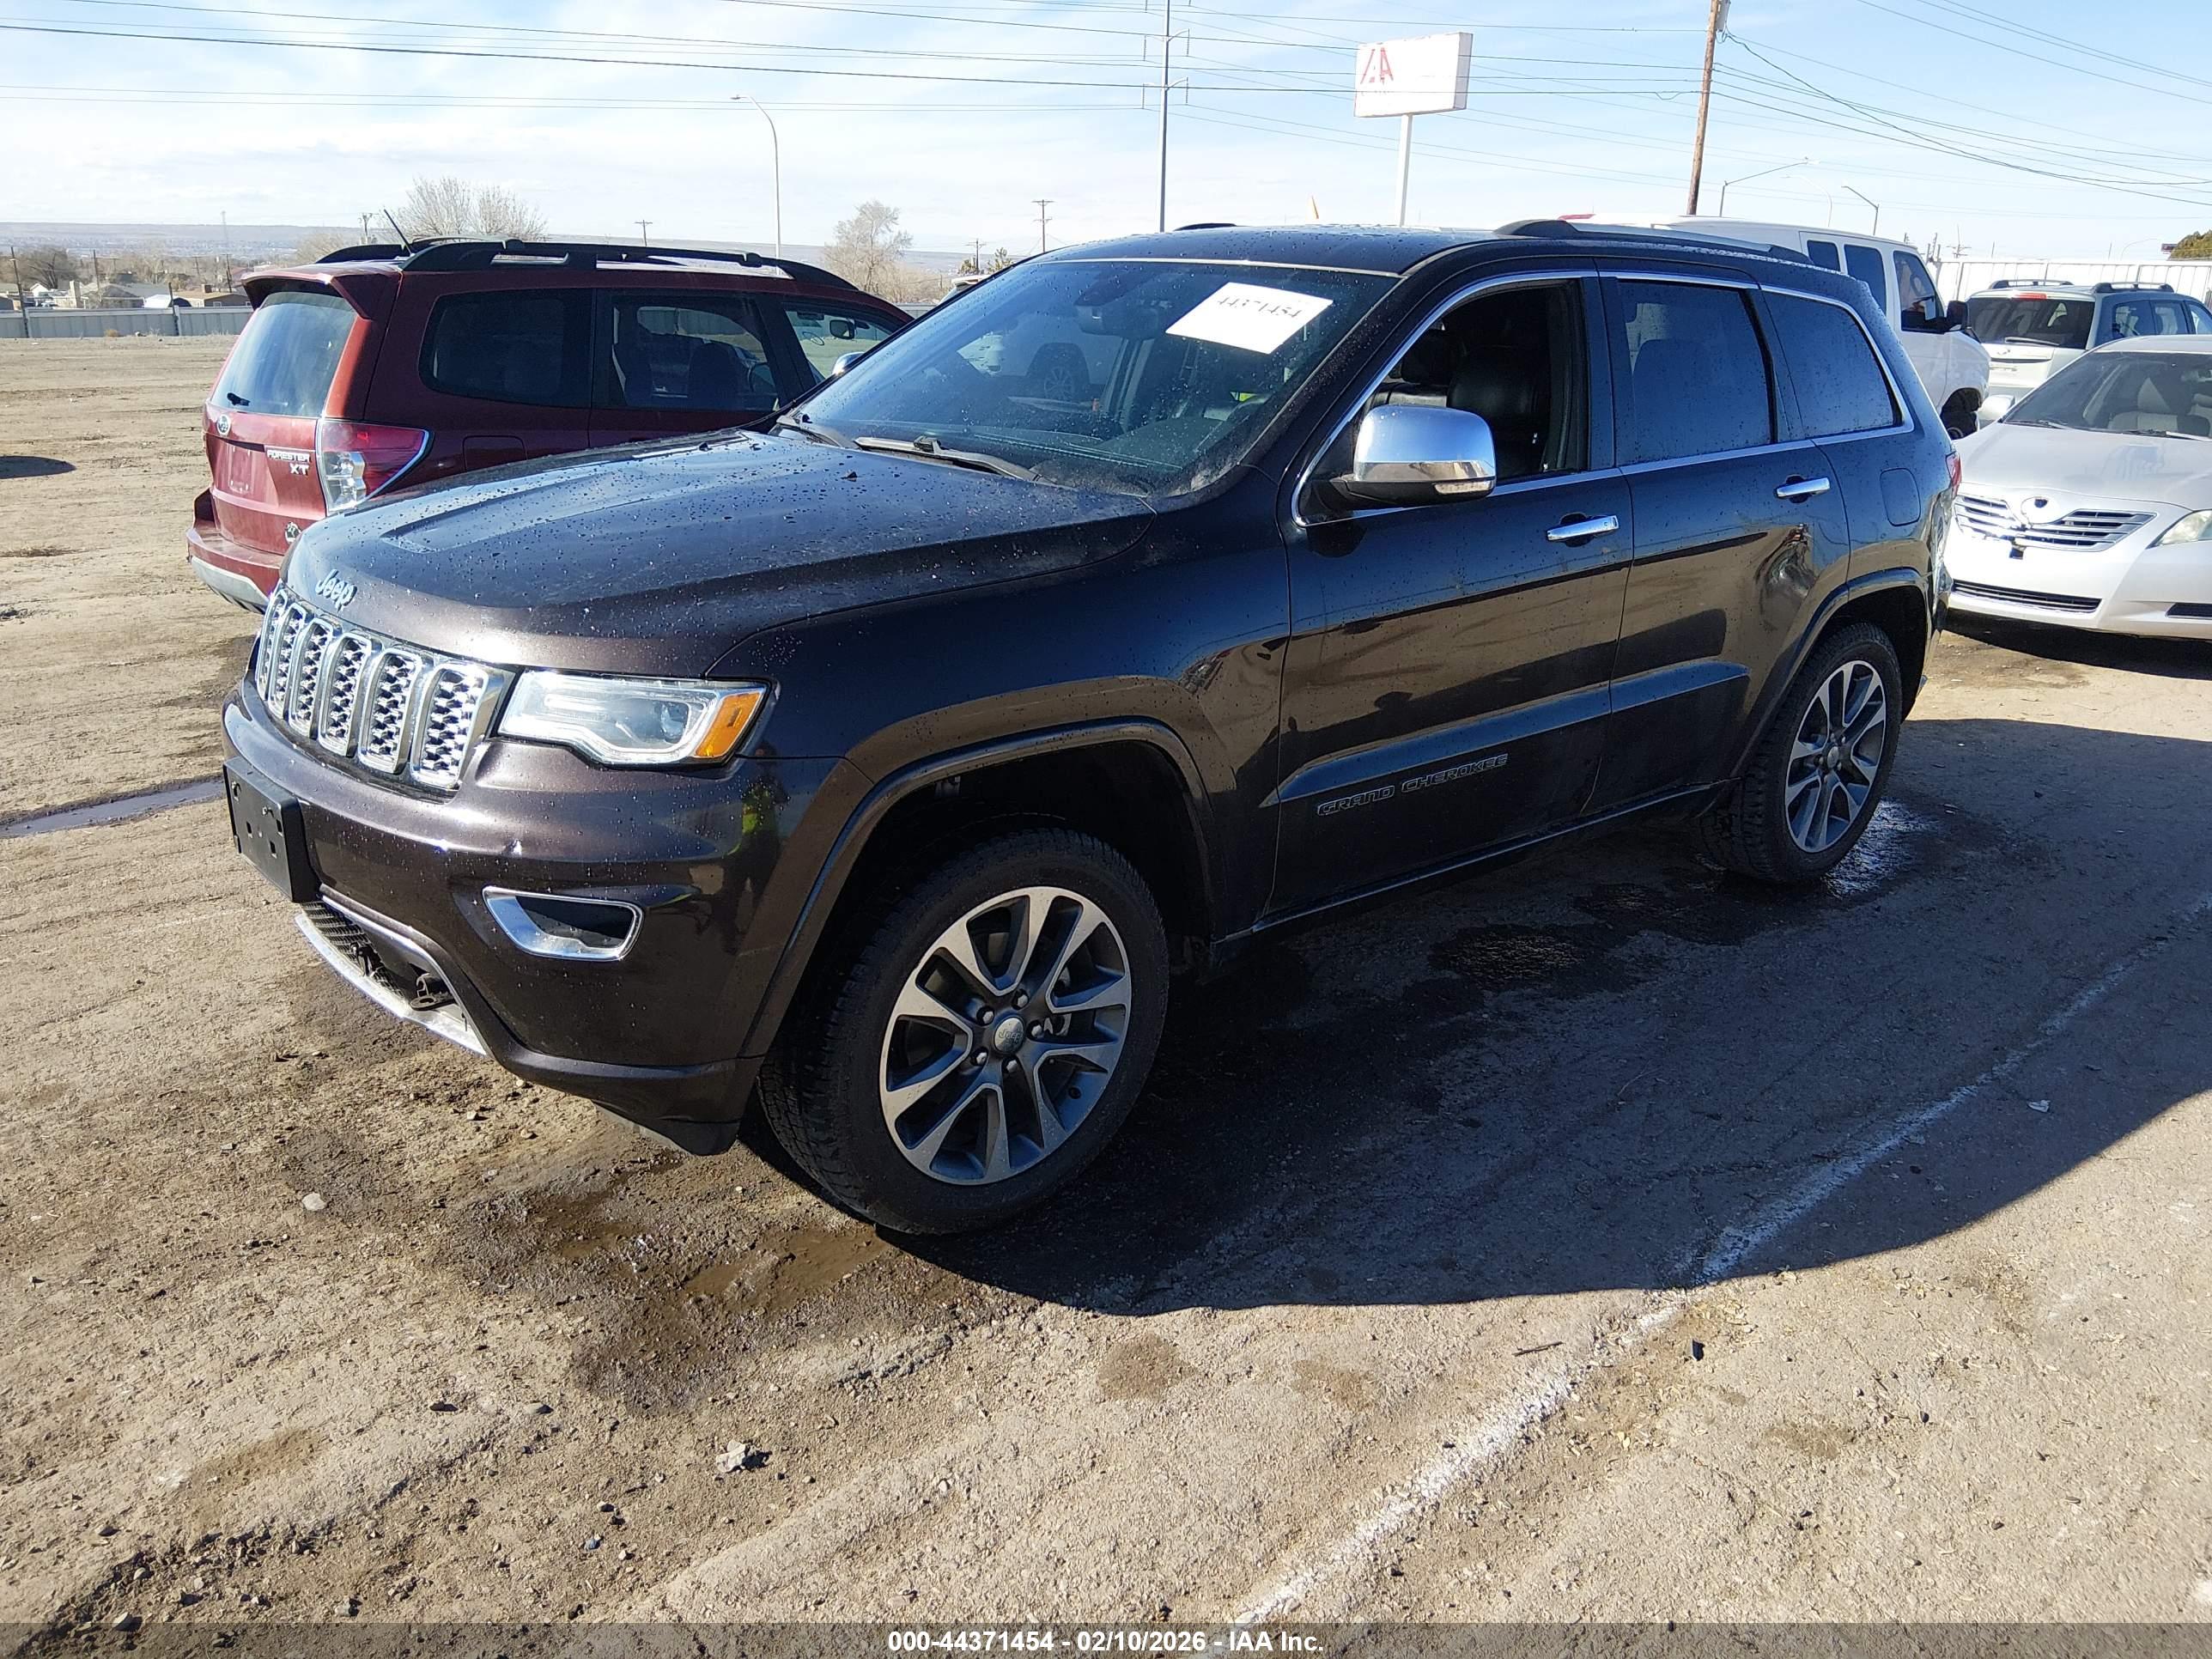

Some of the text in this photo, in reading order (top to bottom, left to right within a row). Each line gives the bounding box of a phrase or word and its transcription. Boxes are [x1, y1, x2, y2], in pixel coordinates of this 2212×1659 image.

[266, 449, 311, 463] FORESTER
[289, 463, 310, 475] XT
[314, 568, 358, 612] Jeep
[1317, 753, 1509, 817] GRAND CHEROKEE
[998, 1029, 1021, 1045] Jeep
